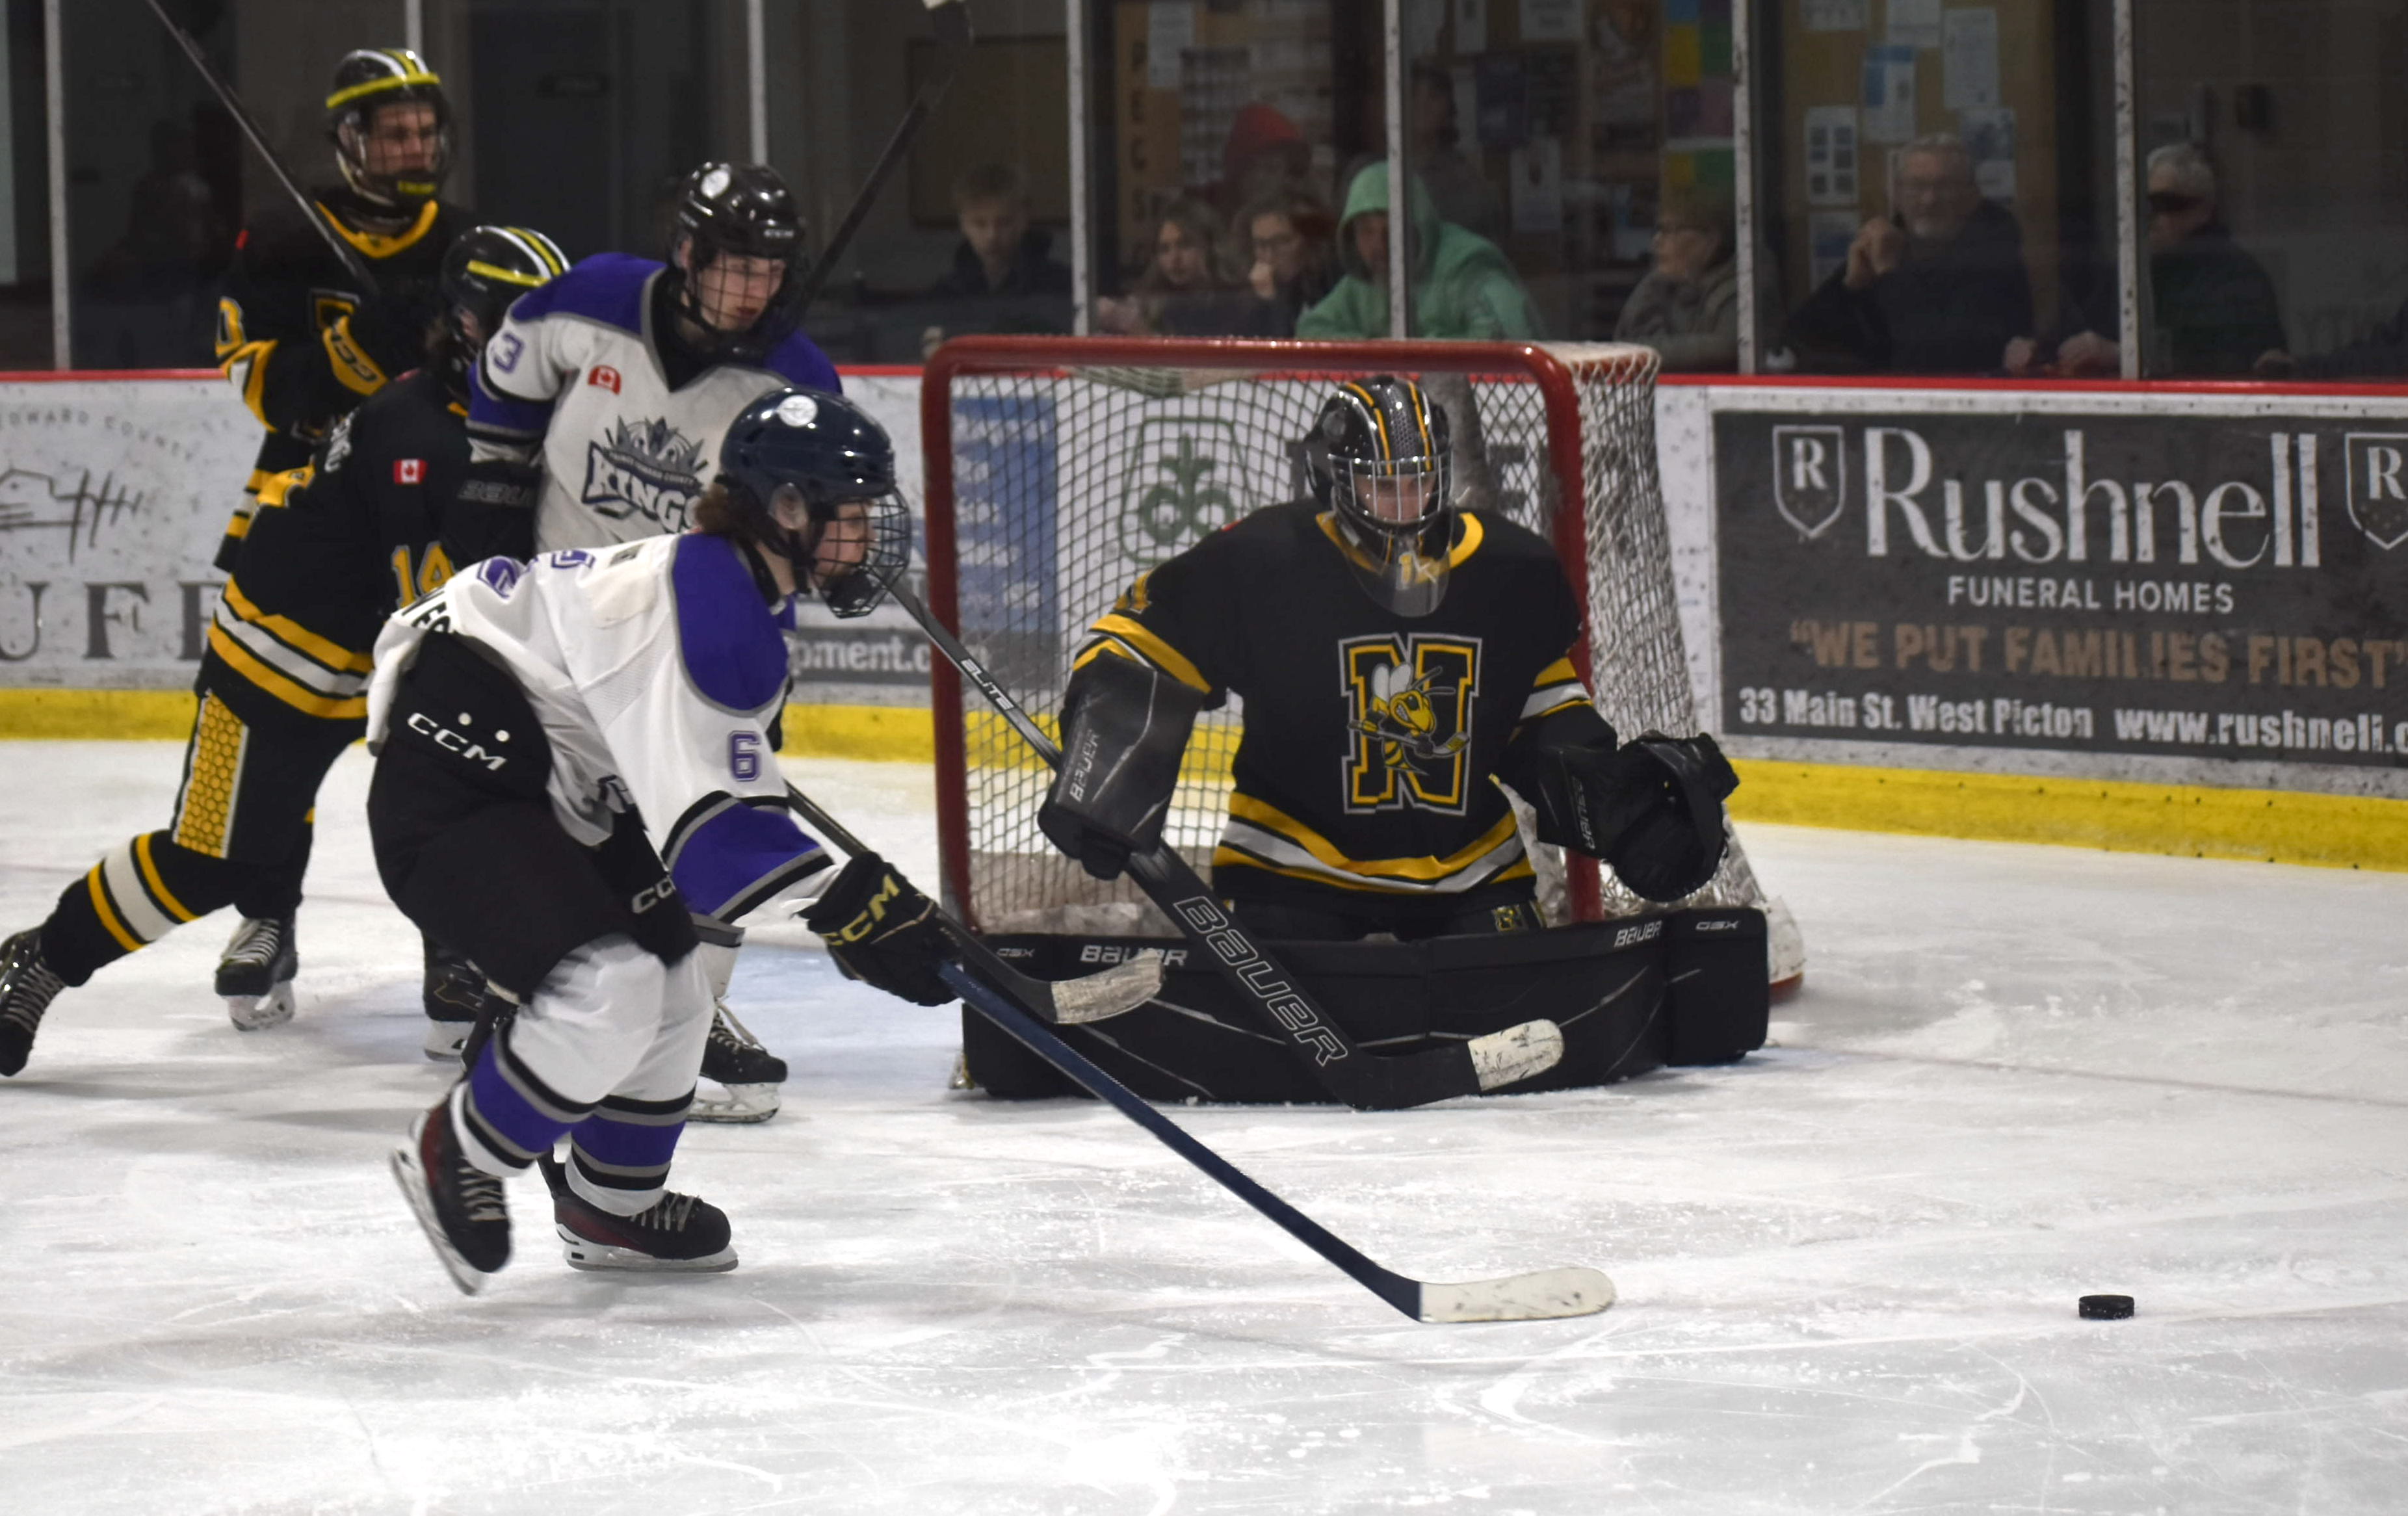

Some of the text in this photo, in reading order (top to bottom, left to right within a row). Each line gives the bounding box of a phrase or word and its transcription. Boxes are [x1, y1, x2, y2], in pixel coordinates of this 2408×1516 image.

[493, 332, 526, 374] 3
[0, 408, 90, 426] DWARD
[1792, 438, 1827, 491] R
[2367, 446, 2407, 500] R
[1863, 426, 2321, 569] Rushnell
[1947, 575, 2234, 614] FUNERAL HOMES
[1894, 623, 1987, 672] PUT
[2004, 627, 2230, 683] FAMILIES
[1738, 686, 1777, 724] 33
[1783, 689, 1857, 727] Main
[1862, 692, 1903, 730] St.
[1907, 694, 1987, 733] West
[1993, 698, 2094, 738] Picton
[407, 712, 507, 772] CCM
[727, 729, 762, 781] 6
[631, 875, 677, 914] CC
[819, 873, 900, 947] CCM
